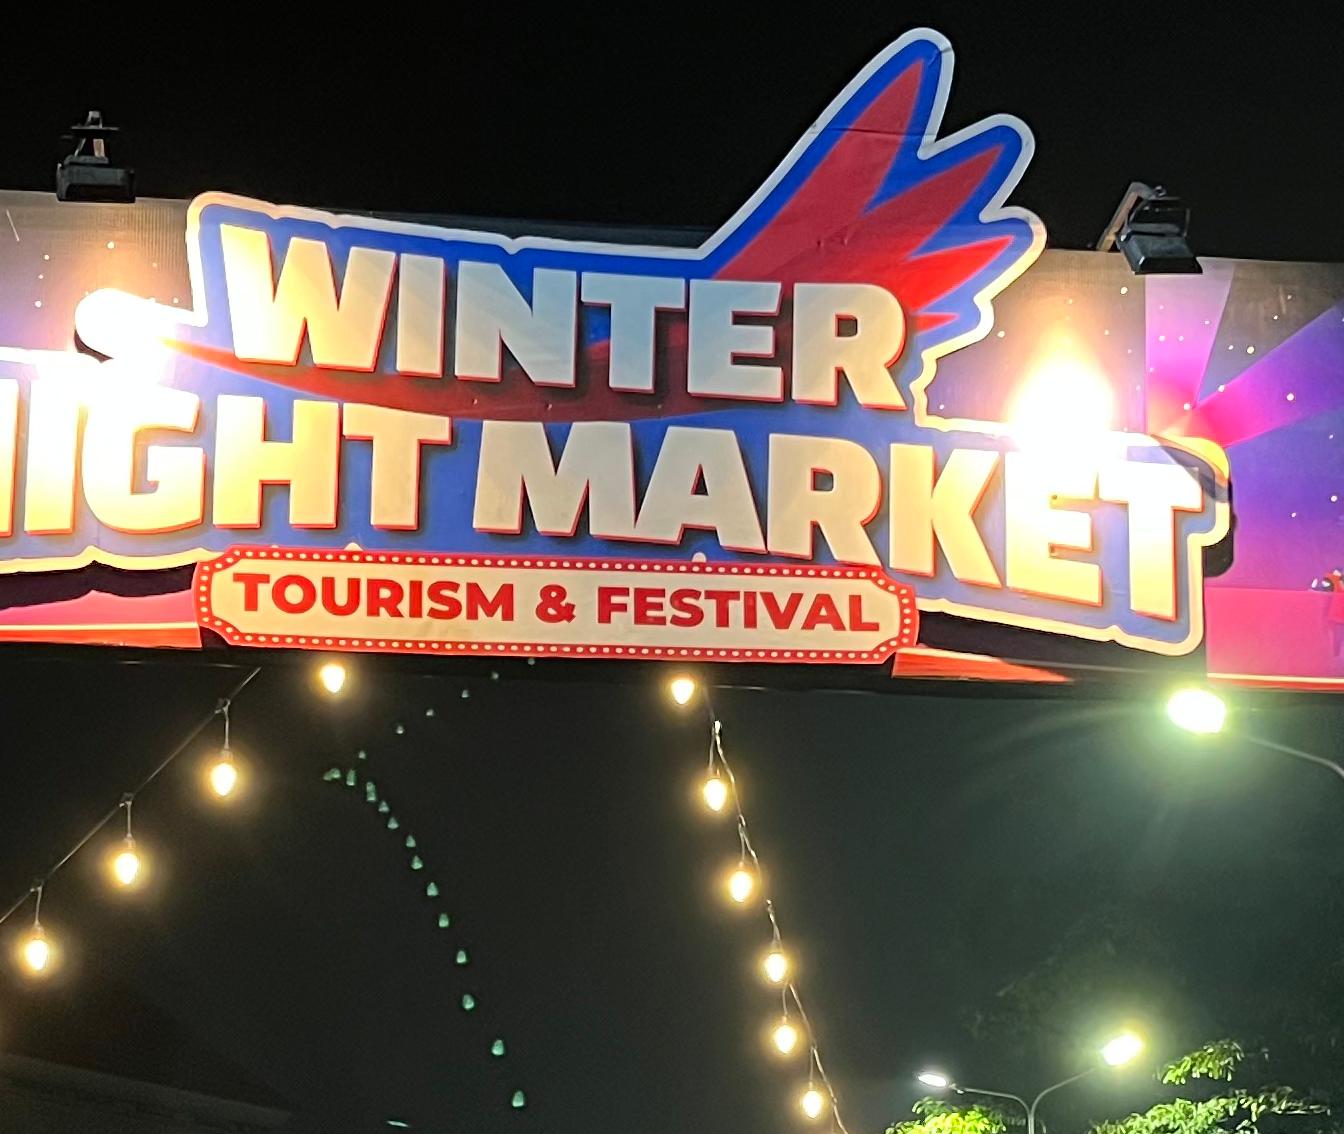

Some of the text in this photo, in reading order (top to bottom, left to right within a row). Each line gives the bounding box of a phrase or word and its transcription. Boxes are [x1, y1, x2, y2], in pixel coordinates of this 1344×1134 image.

[221, 224, 908, 412] WINTER
[231, 570, 882, 635] TOURISM & FESTIVAL
[471, 420, 1204, 622] MARKET
